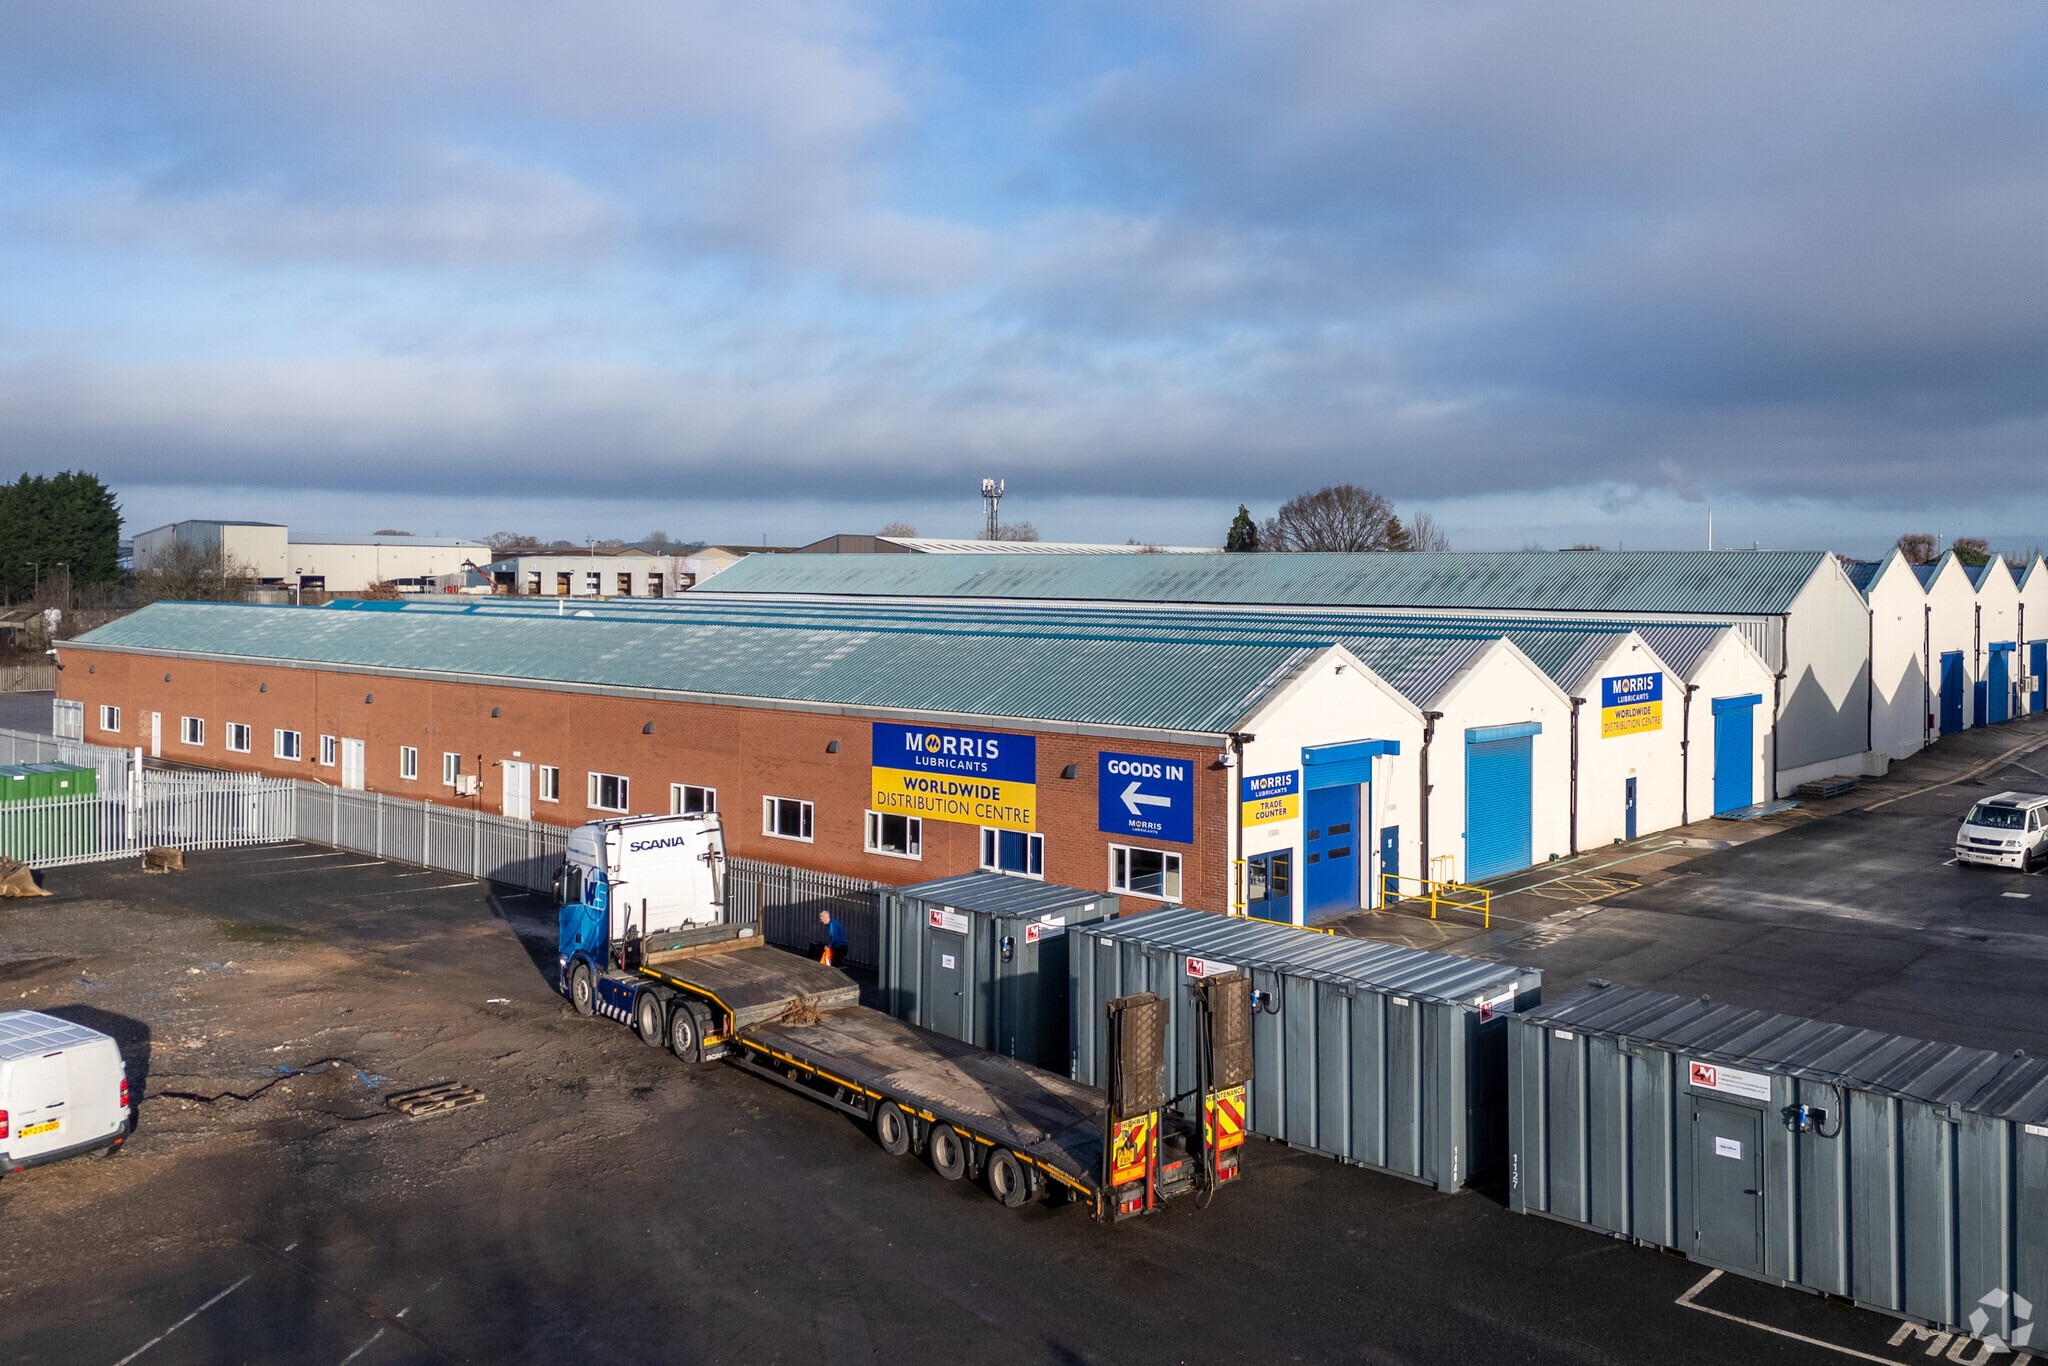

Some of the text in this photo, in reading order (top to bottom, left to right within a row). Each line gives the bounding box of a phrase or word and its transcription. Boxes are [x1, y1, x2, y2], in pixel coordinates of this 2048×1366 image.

[1612, 676, 1654, 694] MORRIS
[1617, 693, 1649, 704] LUBRICANTS
[1615, 706, 1651, 718] WORLDWIDE
[1604, 716, 1661, 733] DISTRIBUTION CENTRE
[905, 732, 999, 760] MORRIS
[915, 755, 988, 772] LUBRICANTS
[1107, 759, 1184, 781] GOODS IN
[903, 776, 1000, 801] WORLDWIDE
[1251, 774, 1292, 791] MORRIS
[1255, 787, 1287, 798] LUBRICANTS
[877, 791, 1030, 824] DISTRIBUTION CENTRE
[1260, 800, 1282, 810] TRADE
[1255, 808, 1287, 820] COUNTER
[1128, 819, 1162, 831] MORRIS
[630, 836, 685, 852] SCANIA
[1694, 1066, 1715, 1083] 4M
[1206, 1086, 1245, 1102] MANTENANCE
